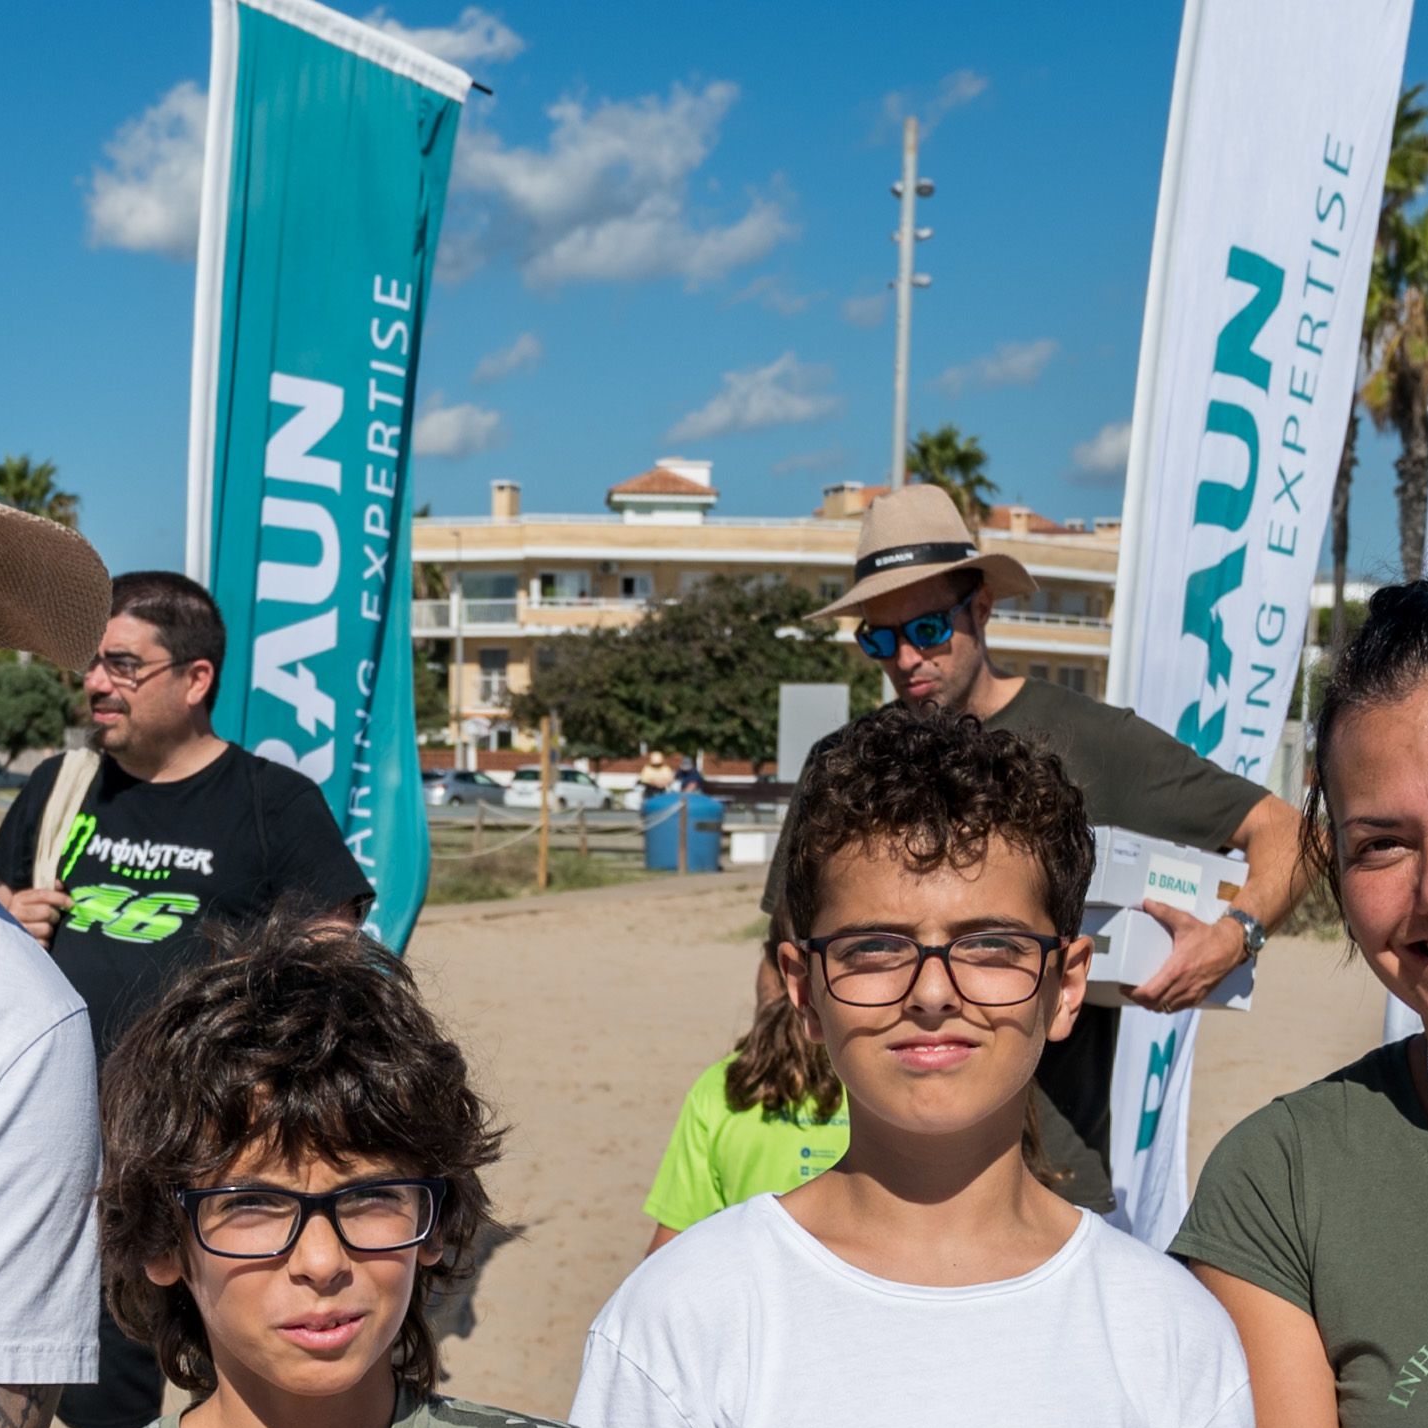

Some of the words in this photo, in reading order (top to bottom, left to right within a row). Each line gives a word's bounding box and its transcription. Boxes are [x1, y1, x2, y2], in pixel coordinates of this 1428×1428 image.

[361, 274, 413, 622] EXPERTISE
[1233, 603, 1288, 778] RING
[1267, 133, 1354, 557] EXPERTISE
[66, 883, 200, 943] 46
[1159, 874, 1198, 897] BRAUN
